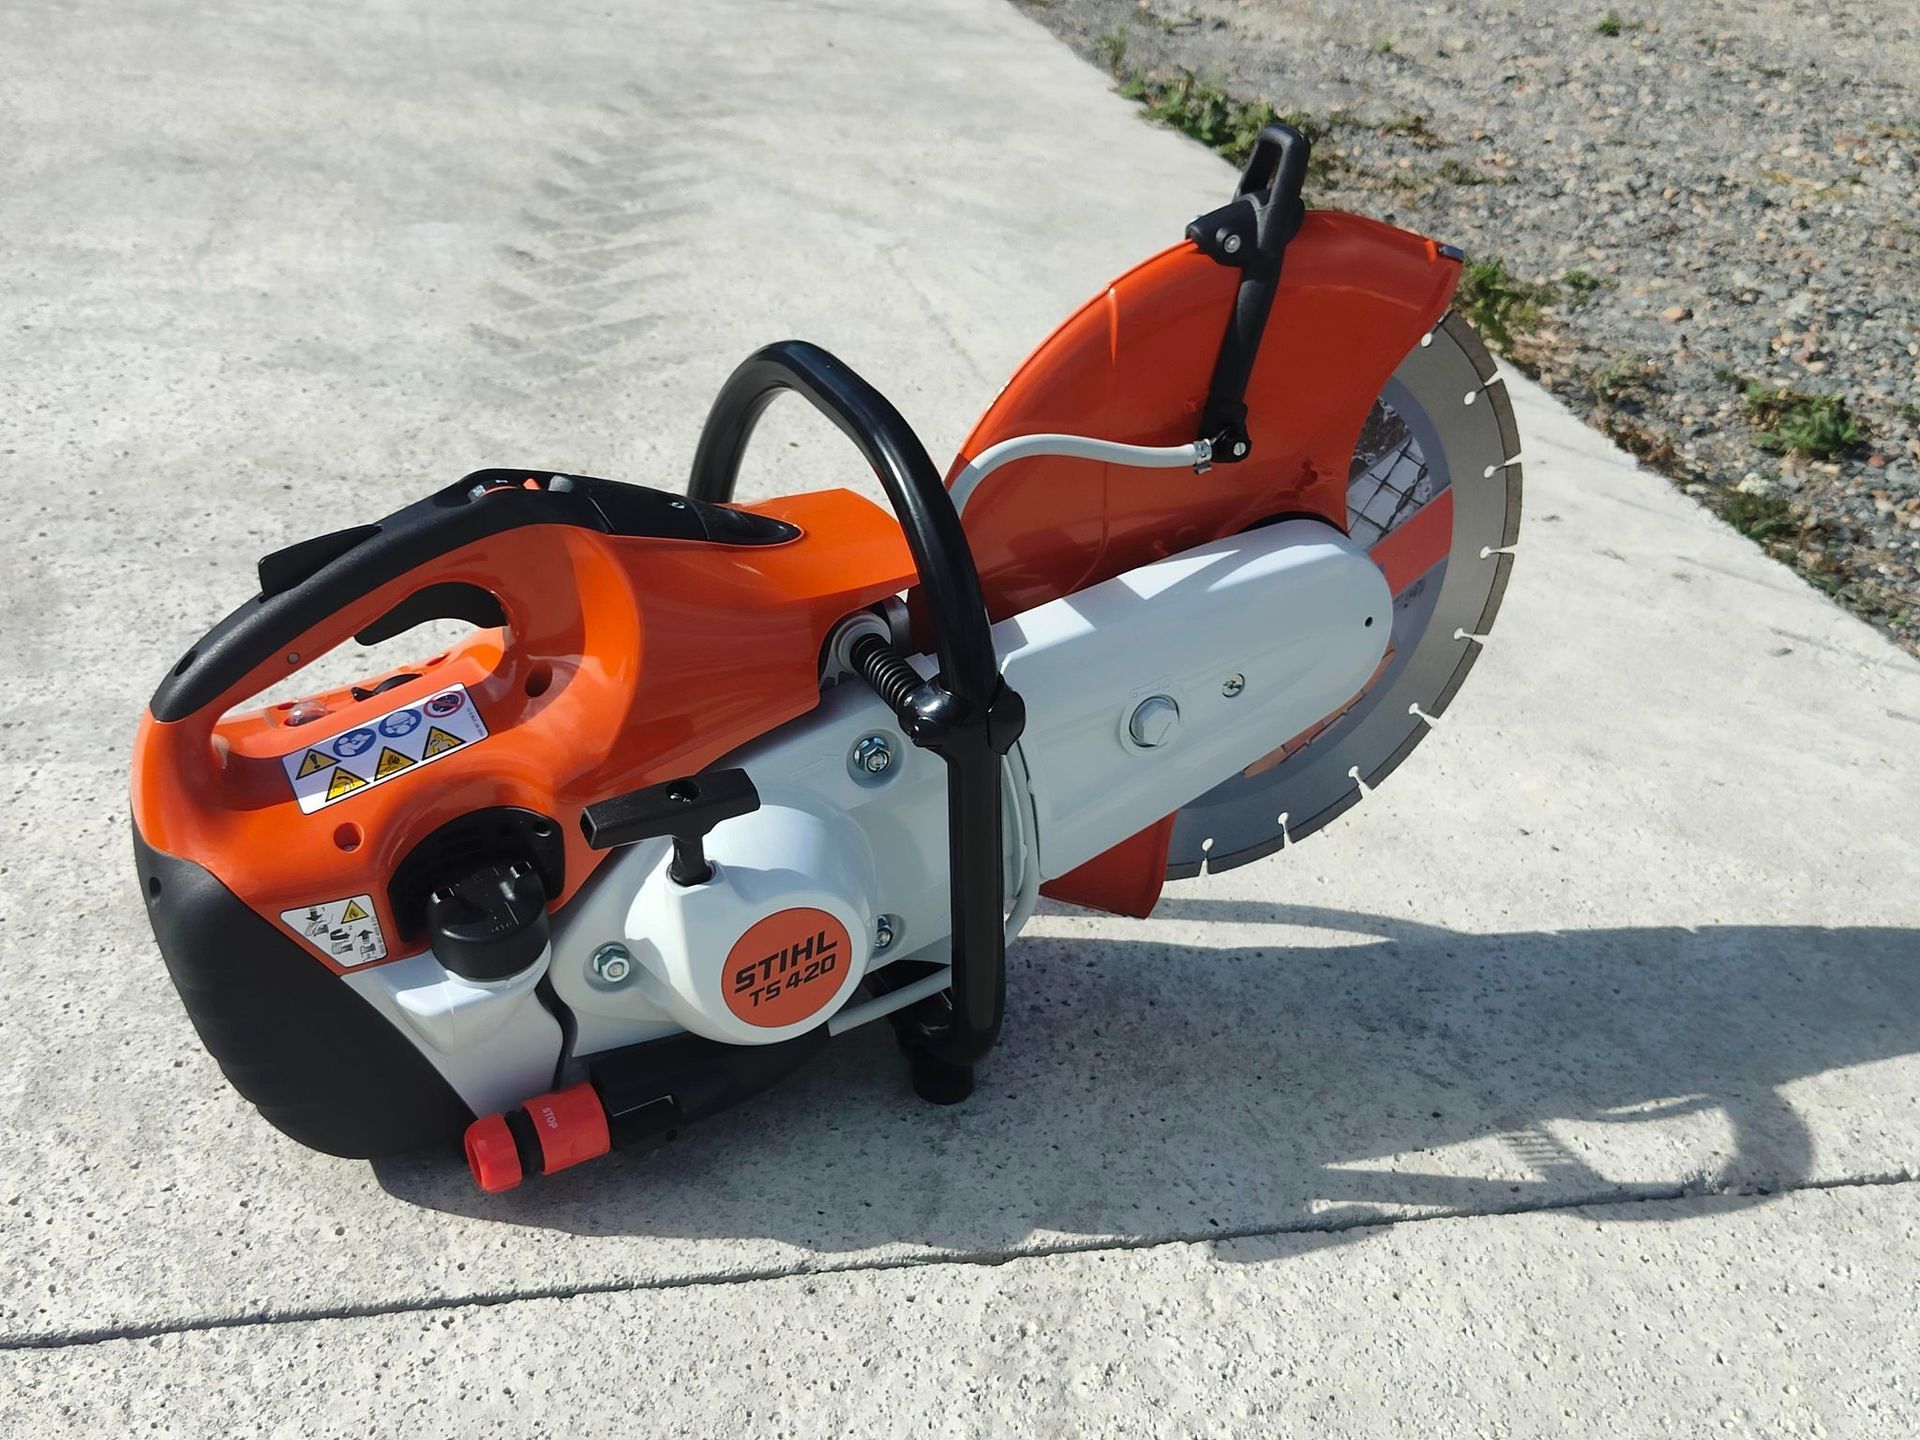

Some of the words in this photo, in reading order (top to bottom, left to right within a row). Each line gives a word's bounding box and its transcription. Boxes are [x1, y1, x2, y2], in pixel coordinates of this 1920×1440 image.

[734, 930, 838, 993] STIHL
[749, 979, 782, 1007] TS
[785, 953, 836, 989] 420
[542, 1105, 559, 1129] STOP
